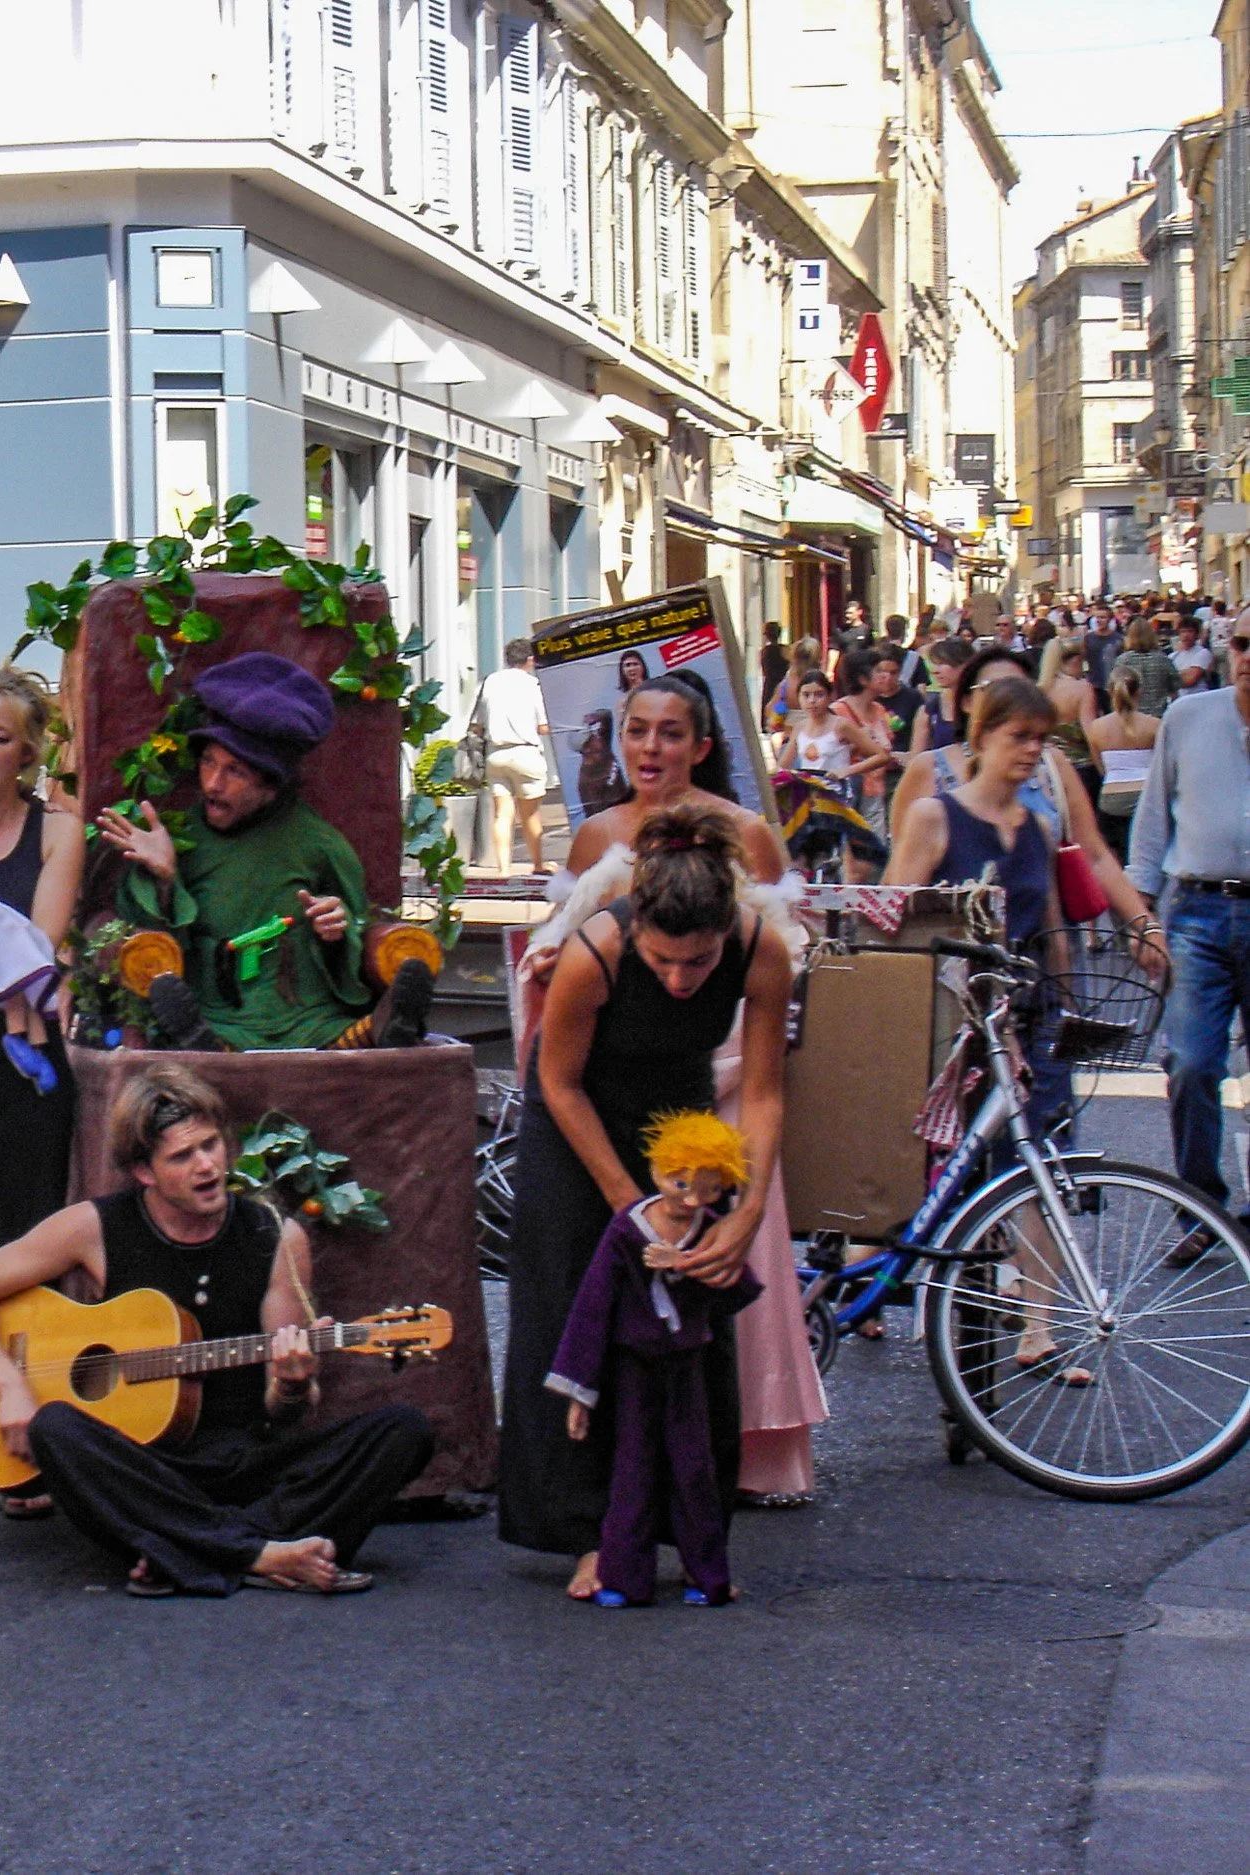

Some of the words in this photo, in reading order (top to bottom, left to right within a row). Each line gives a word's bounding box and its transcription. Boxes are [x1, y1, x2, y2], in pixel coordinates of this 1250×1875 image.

[864, 347, 878, 396] TABAC
[810, 389, 854, 401] PRESSE
[537, 636, 573, 656] Plus
[575, 626, 613, 646] vraie
[616, 619, 648, 637] que
[911, 1136, 979, 1234] GIANT
